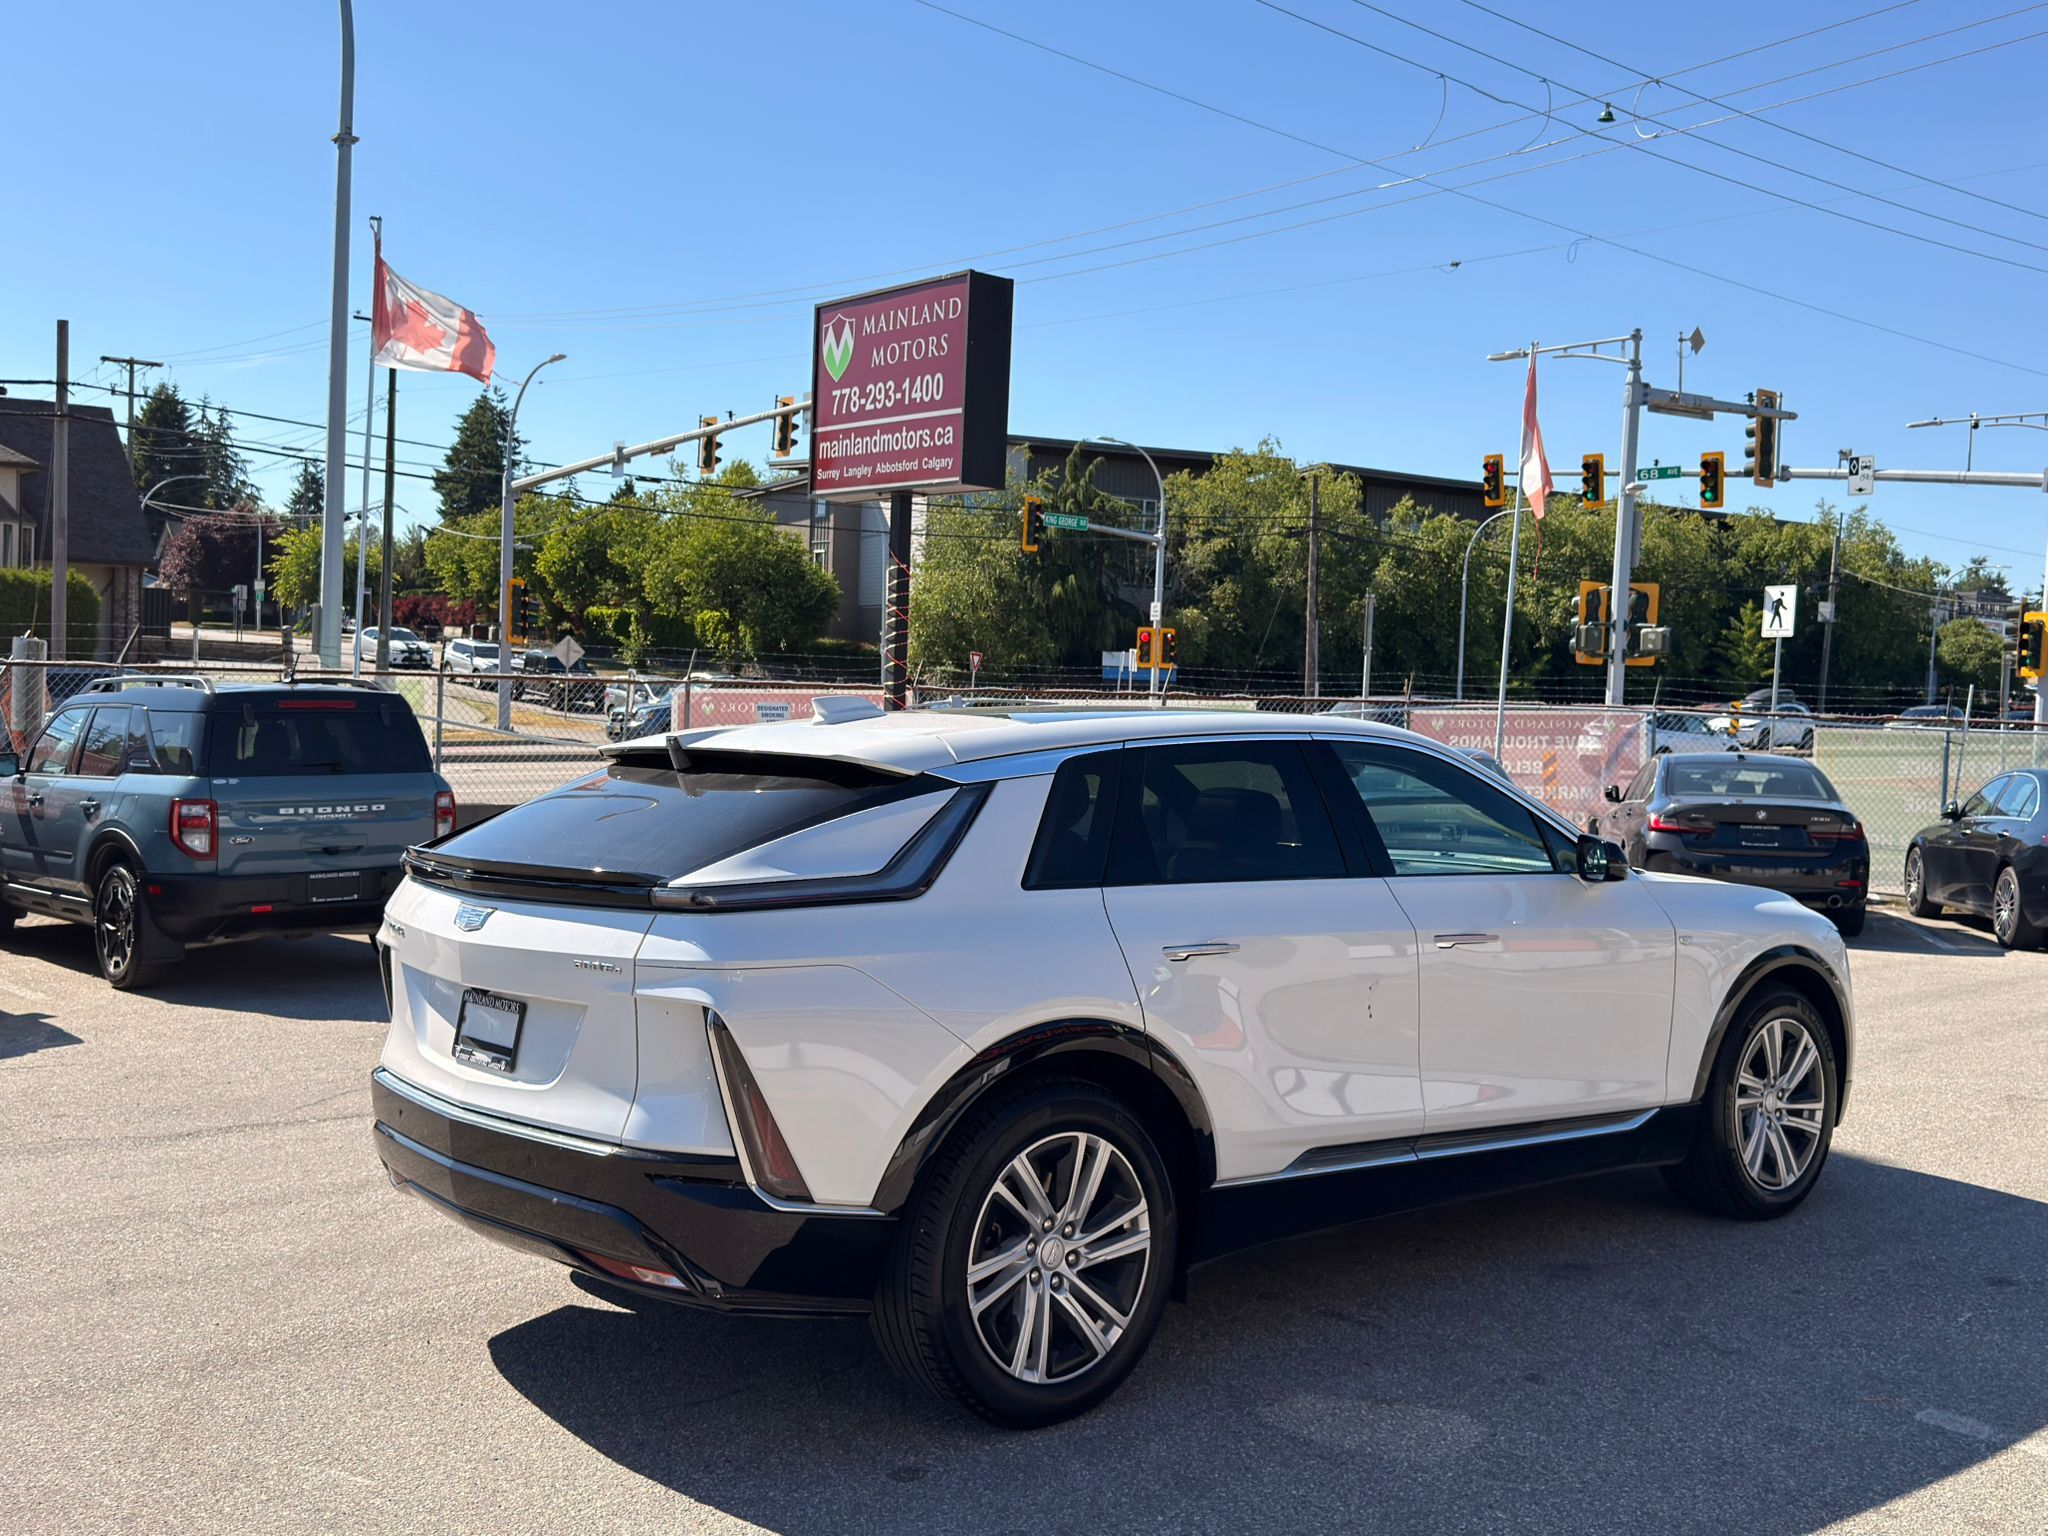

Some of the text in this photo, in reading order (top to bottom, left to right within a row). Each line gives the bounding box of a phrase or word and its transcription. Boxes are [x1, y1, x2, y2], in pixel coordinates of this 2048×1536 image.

[862, 297, 962, 336] MAINLAND
[871, 333, 949, 368] MOTORS
[831, 372, 944, 416] 778-293-1400
[819, 426, 954, 460] mainlandmotors.ca
[817, 456, 954, 480] Surrey Langley Abbotsford Calgary
[1640, 470, 1659, 480] 68
[1045, 515, 1058, 525] KING
[1058, 516, 1078, 527] GEORGE
[278, 804, 386, 815] BRONCO
[463, 991, 520, 1014] MAINLAND MOTORS
